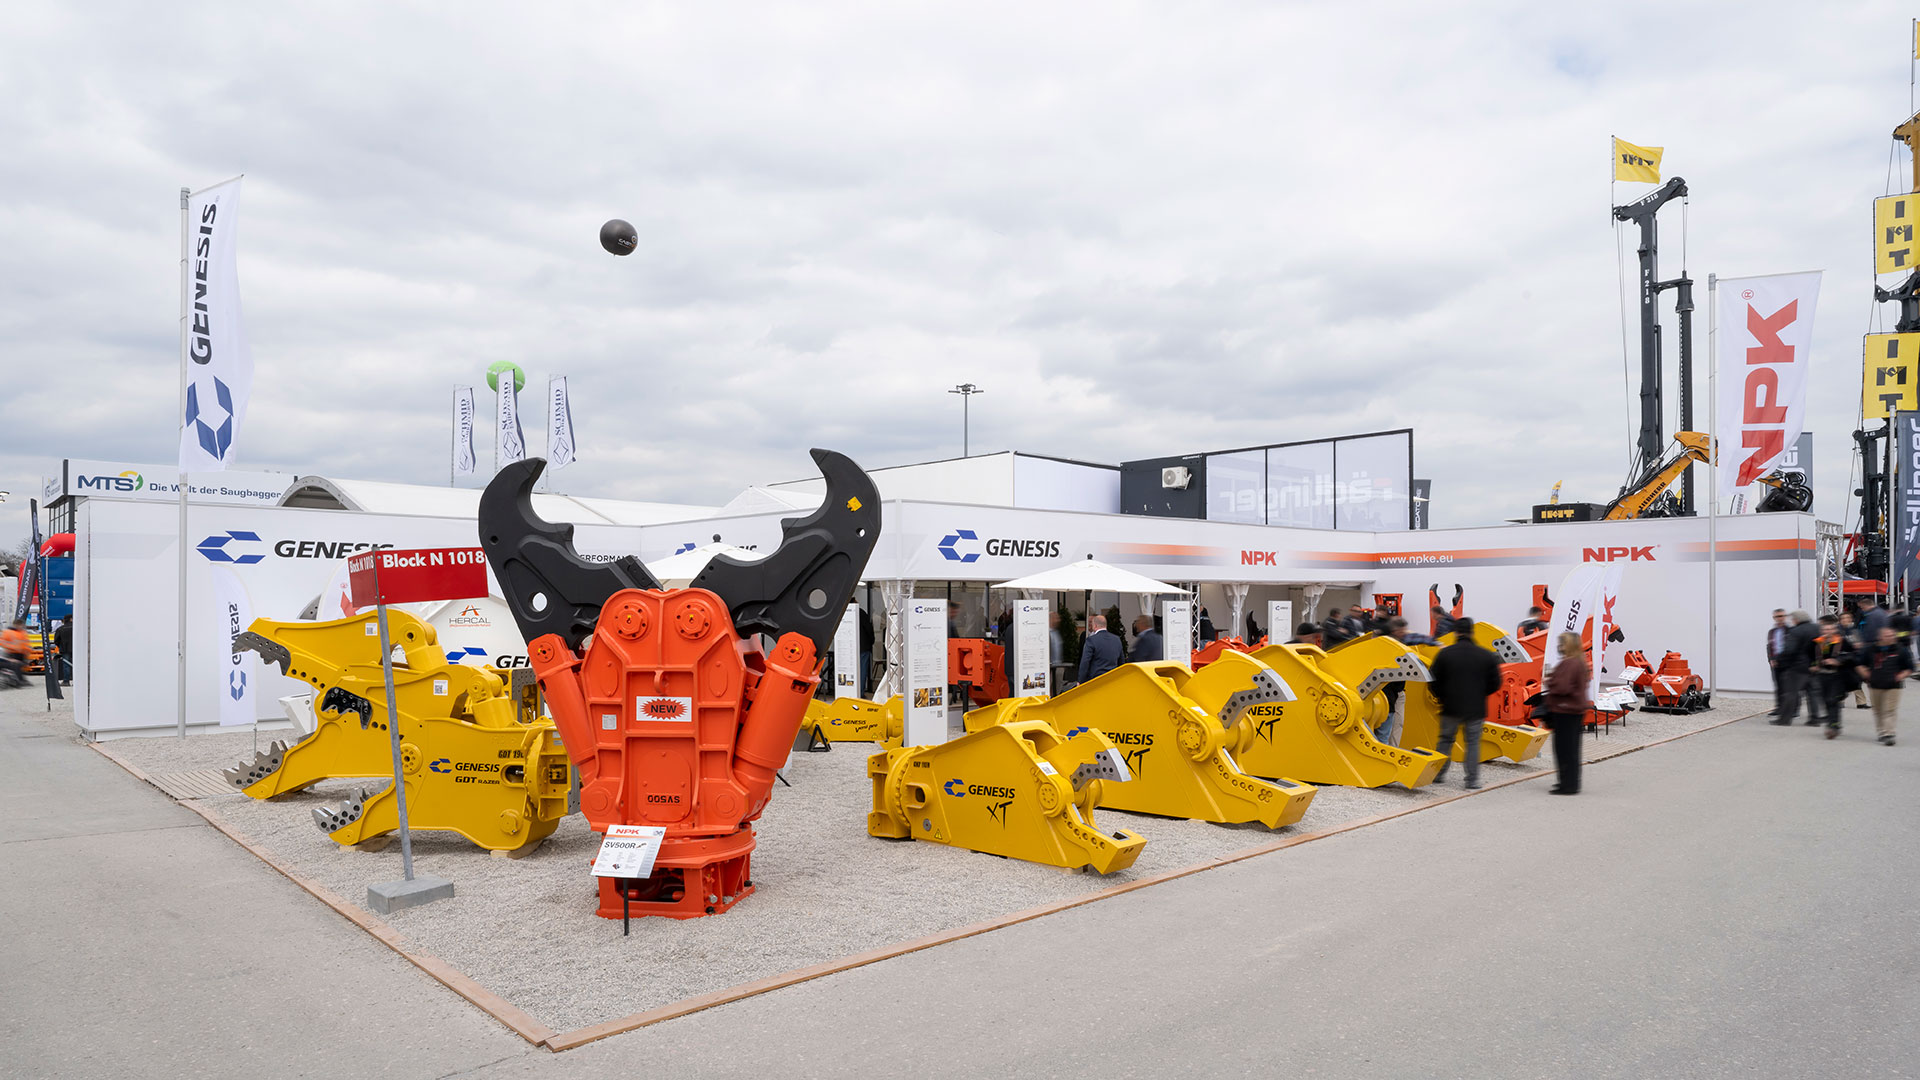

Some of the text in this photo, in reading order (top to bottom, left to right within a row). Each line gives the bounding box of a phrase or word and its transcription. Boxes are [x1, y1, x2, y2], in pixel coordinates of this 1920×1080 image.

[1886, 200, 1913, 267] IMT
[190, 202, 217, 365] GENESIS
[1876, 339, 1907, 412] IMT
[1735, 298, 1798, 487] NPK
[77, 475, 134, 491] MTS
[150, 482, 282, 499] Die Wlt der Saugbagger
[1638, 481, 1667, 511] LIEBHERR
[1541, 509, 1575, 519] IMT
[986, 539, 1060, 558] GENESIS
[1582, 546, 1656, 562] NPK
[383, 551, 485, 568] Block N 1018
[1241, 550, 1277, 566] NPK
[1380, 553, 1454, 566] www.npke.eu
[1564, 599, 1581, 632] ESIS
[650, 704, 677, 714] NEW
[1247, 706, 1283, 717] NESIS
[1102, 732, 1154, 746] ENESIS
[455, 762, 500, 773] GENESIS
[455, 776, 477, 784] GDT
[968, 784, 1016, 799] GENESIS
[986, 800, 1013, 830] XT
[604, 841, 637, 849] SV500R
